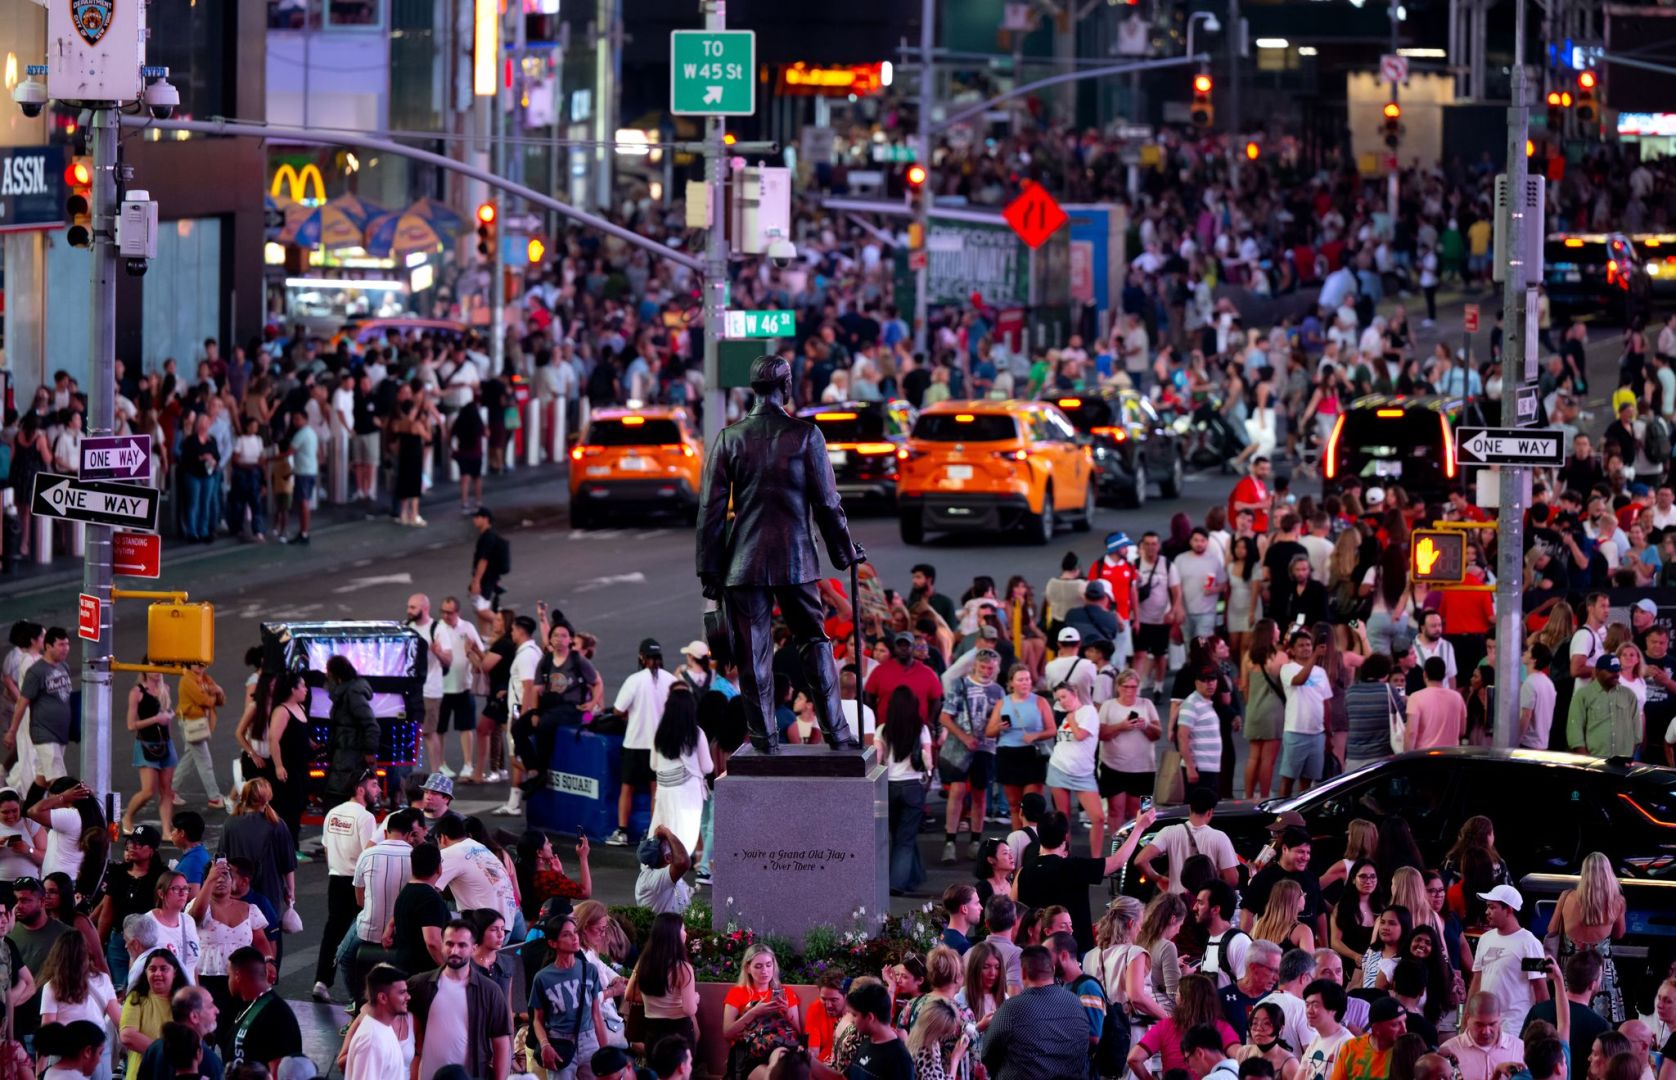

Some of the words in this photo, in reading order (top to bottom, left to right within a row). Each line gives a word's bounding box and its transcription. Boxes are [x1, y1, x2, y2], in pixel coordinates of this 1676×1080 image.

[702, 40, 724, 57] TO
[142, 67, 166, 77] NYPD
[683, 63, 697, 79] W
[699, 63, 723, 79] 45
[726, 63, 742, 80] St
[1, 156, 48, 195] ASSN.
[746, 314, 757, 333] W
[761, 314, 779, 333] 46
[1473, 439, 1503, 453] ONE
[1518, 440, 1550, 454] WAY
[90, 451, 110, 468] ONE
[119, 449, 139, 466] WAY
[53, 488, 87, 508] ONE
[104, 495, 142, 515] WAY
[122, 537, 148, 547] STANDING
[742, 849, 766, 860] You're
[768, 850, 776, 859] a
[778, 849, 805, 860] Grand
[808, 849, 823, 859] Old
[827, 848, 846, 861] Flag
[770, 860, 791, 871] Over
[794, 860, 816, 871] There
